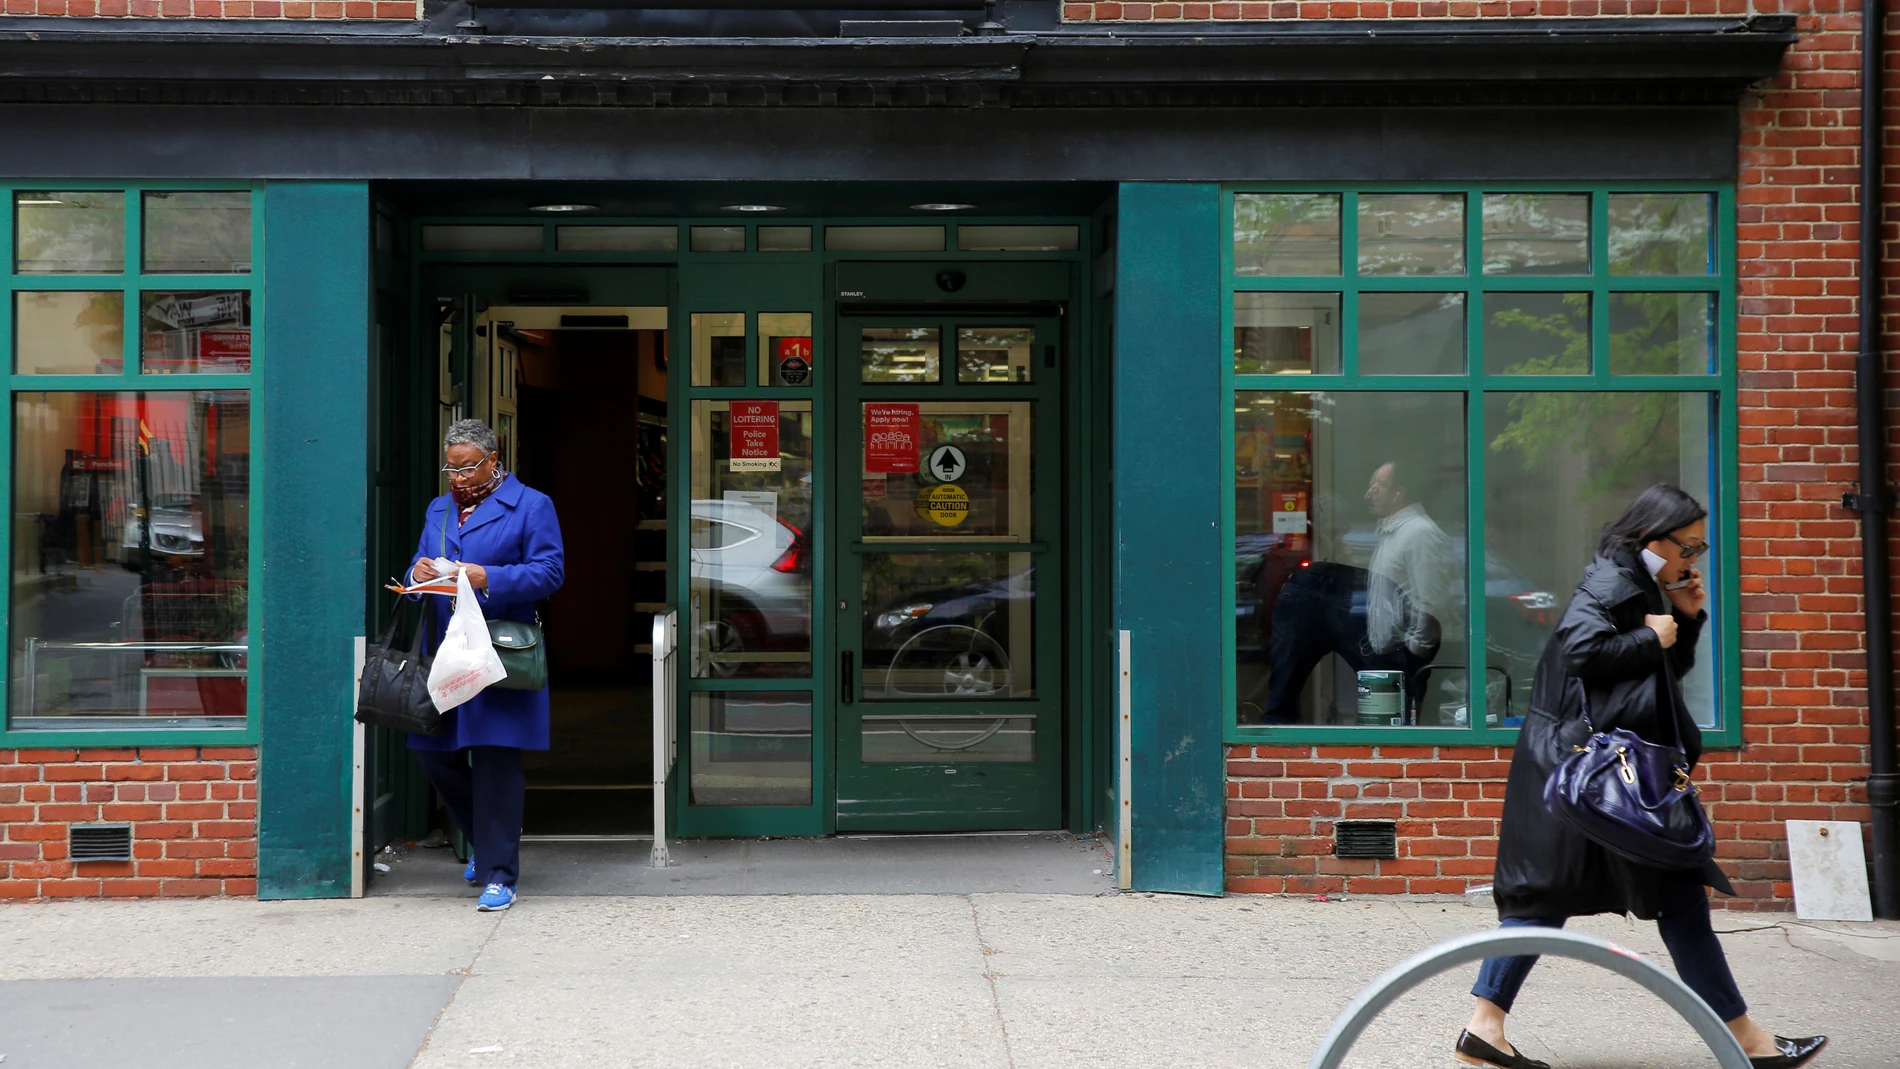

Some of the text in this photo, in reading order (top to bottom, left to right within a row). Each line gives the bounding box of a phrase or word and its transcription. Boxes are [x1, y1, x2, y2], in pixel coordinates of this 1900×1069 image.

[792, 343, 800, 357] 1
[747, 406, 762, 414] NO
[891, 409, 914, 417] hiring.
[870, 416, 891, 424] Apply
[743, 430, 767, 438] Police
[746, 439, 764, 447] Take
[742, 448, 768, 456] Notice
[930, 502, 967, 510] CAUTION
